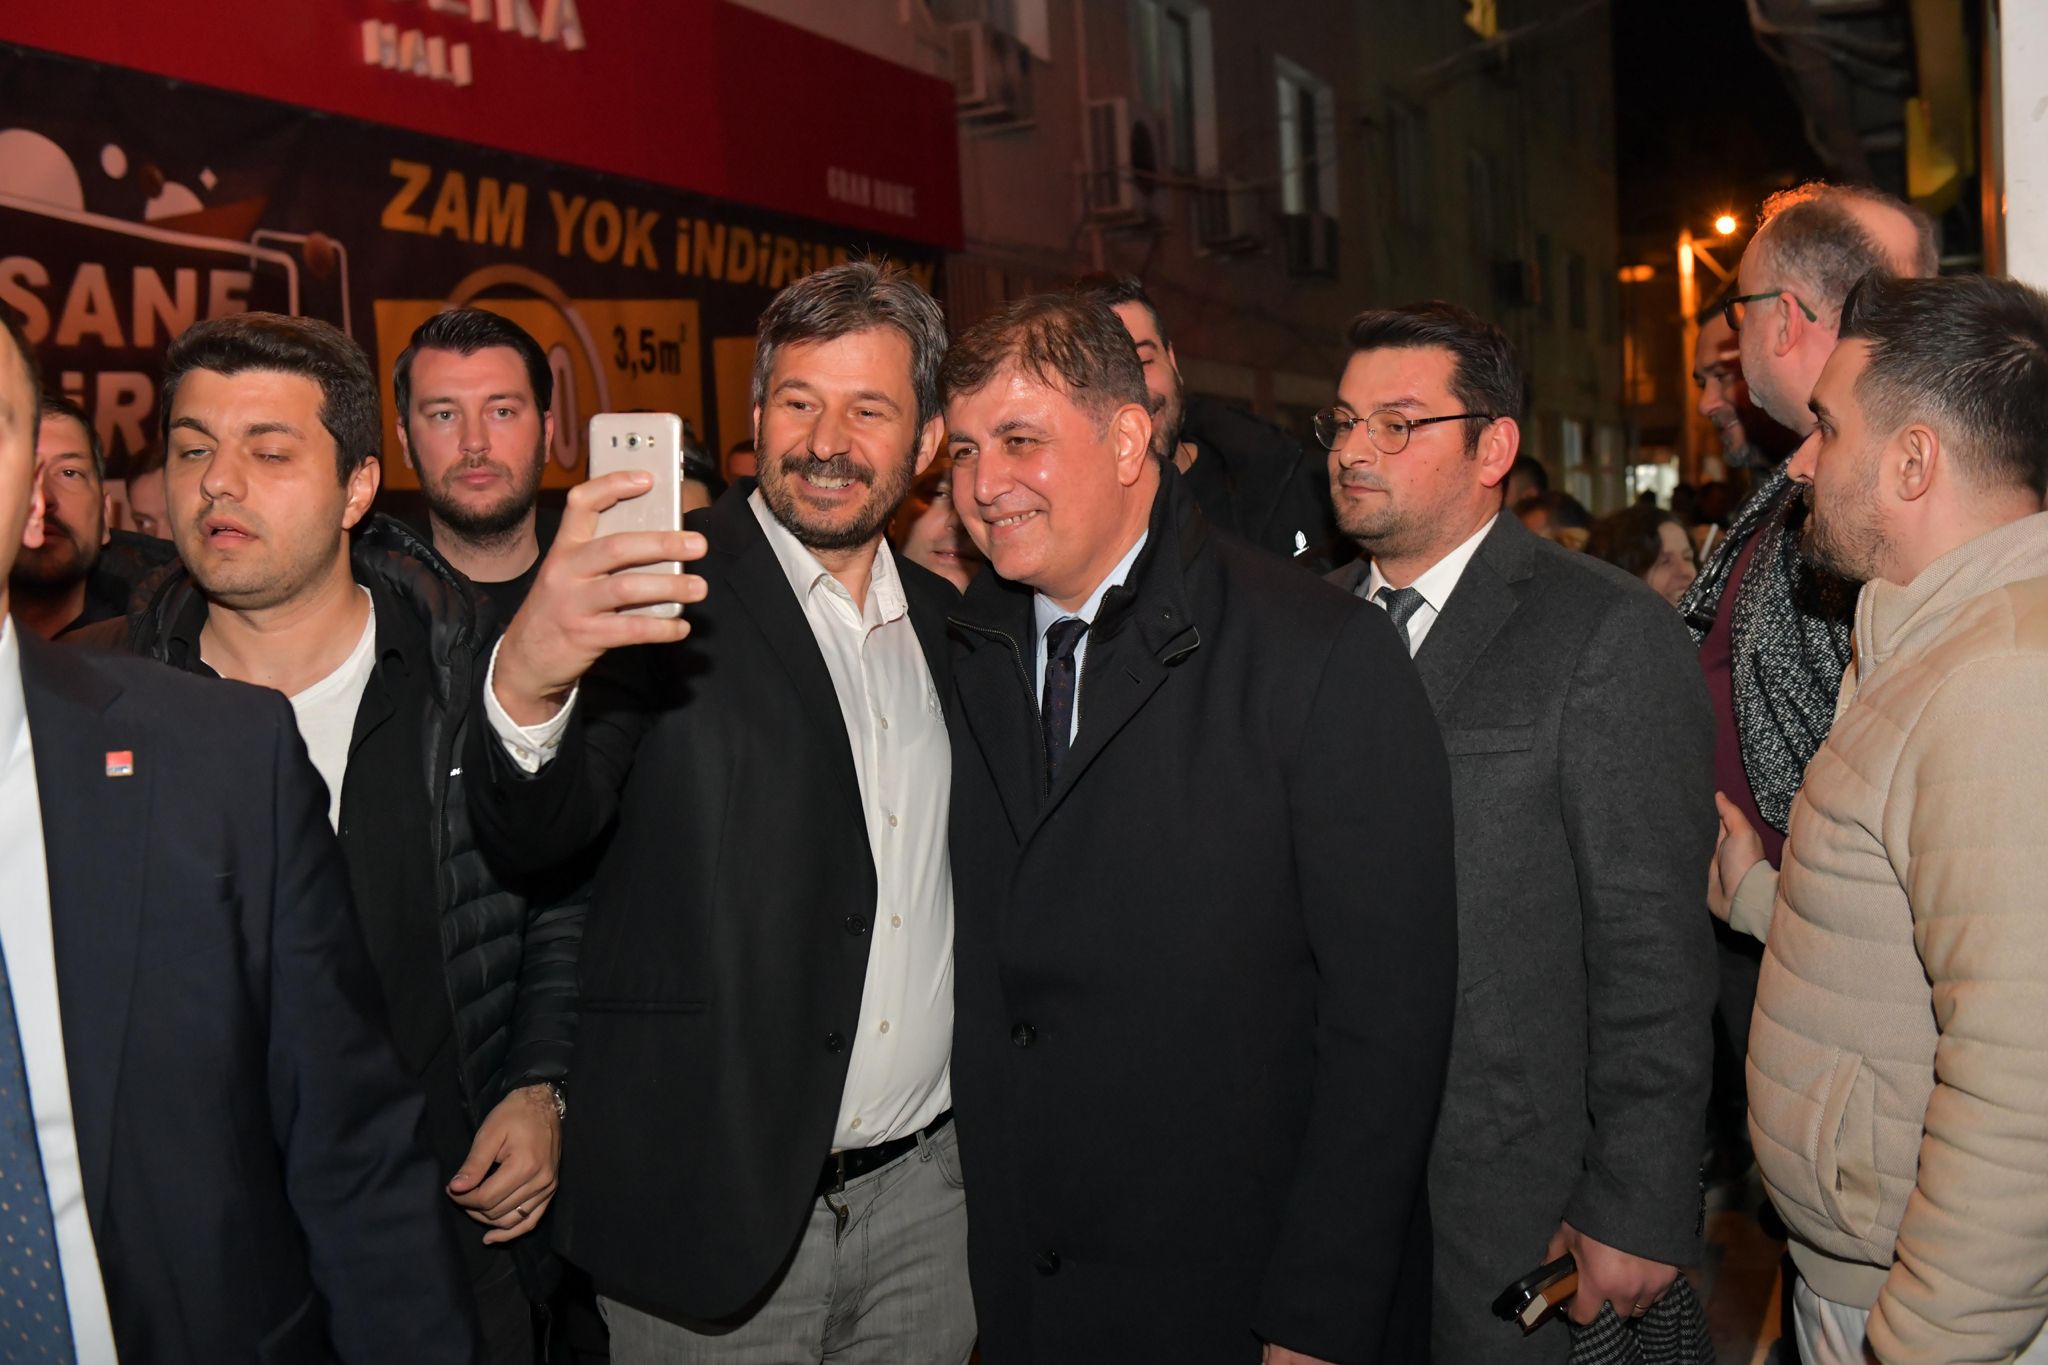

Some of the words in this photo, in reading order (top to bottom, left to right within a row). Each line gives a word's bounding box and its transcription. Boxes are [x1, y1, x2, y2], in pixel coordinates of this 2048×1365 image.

[362, 18, 472, 87] HALI
[381, 159, 528, 249] ZAM
[548, 190, 660, 270] YOK
